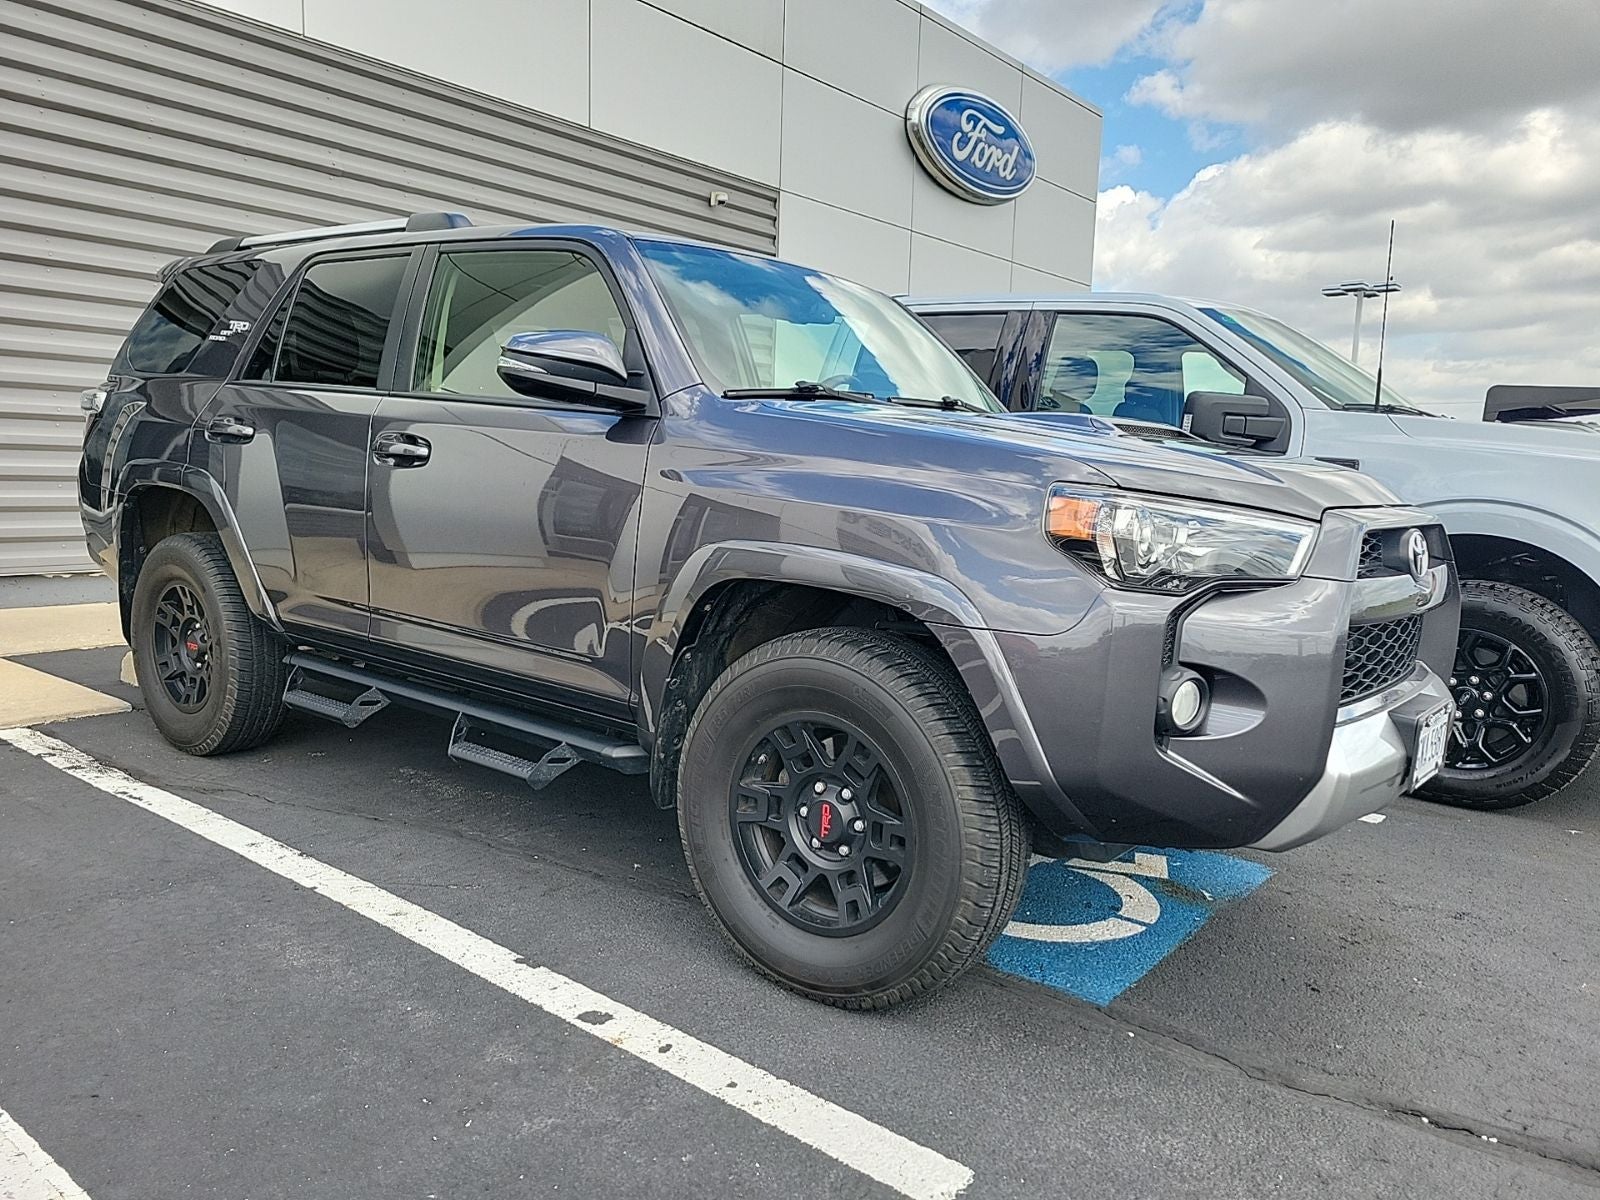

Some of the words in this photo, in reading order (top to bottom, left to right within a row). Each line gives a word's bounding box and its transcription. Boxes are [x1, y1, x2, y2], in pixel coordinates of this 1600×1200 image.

[952, 108, 1020, 181] Ford
[229, 320, 250, 333] TRD
[186, 641, 199, 650] TRD
[820, 803, 832, 838] TRD
